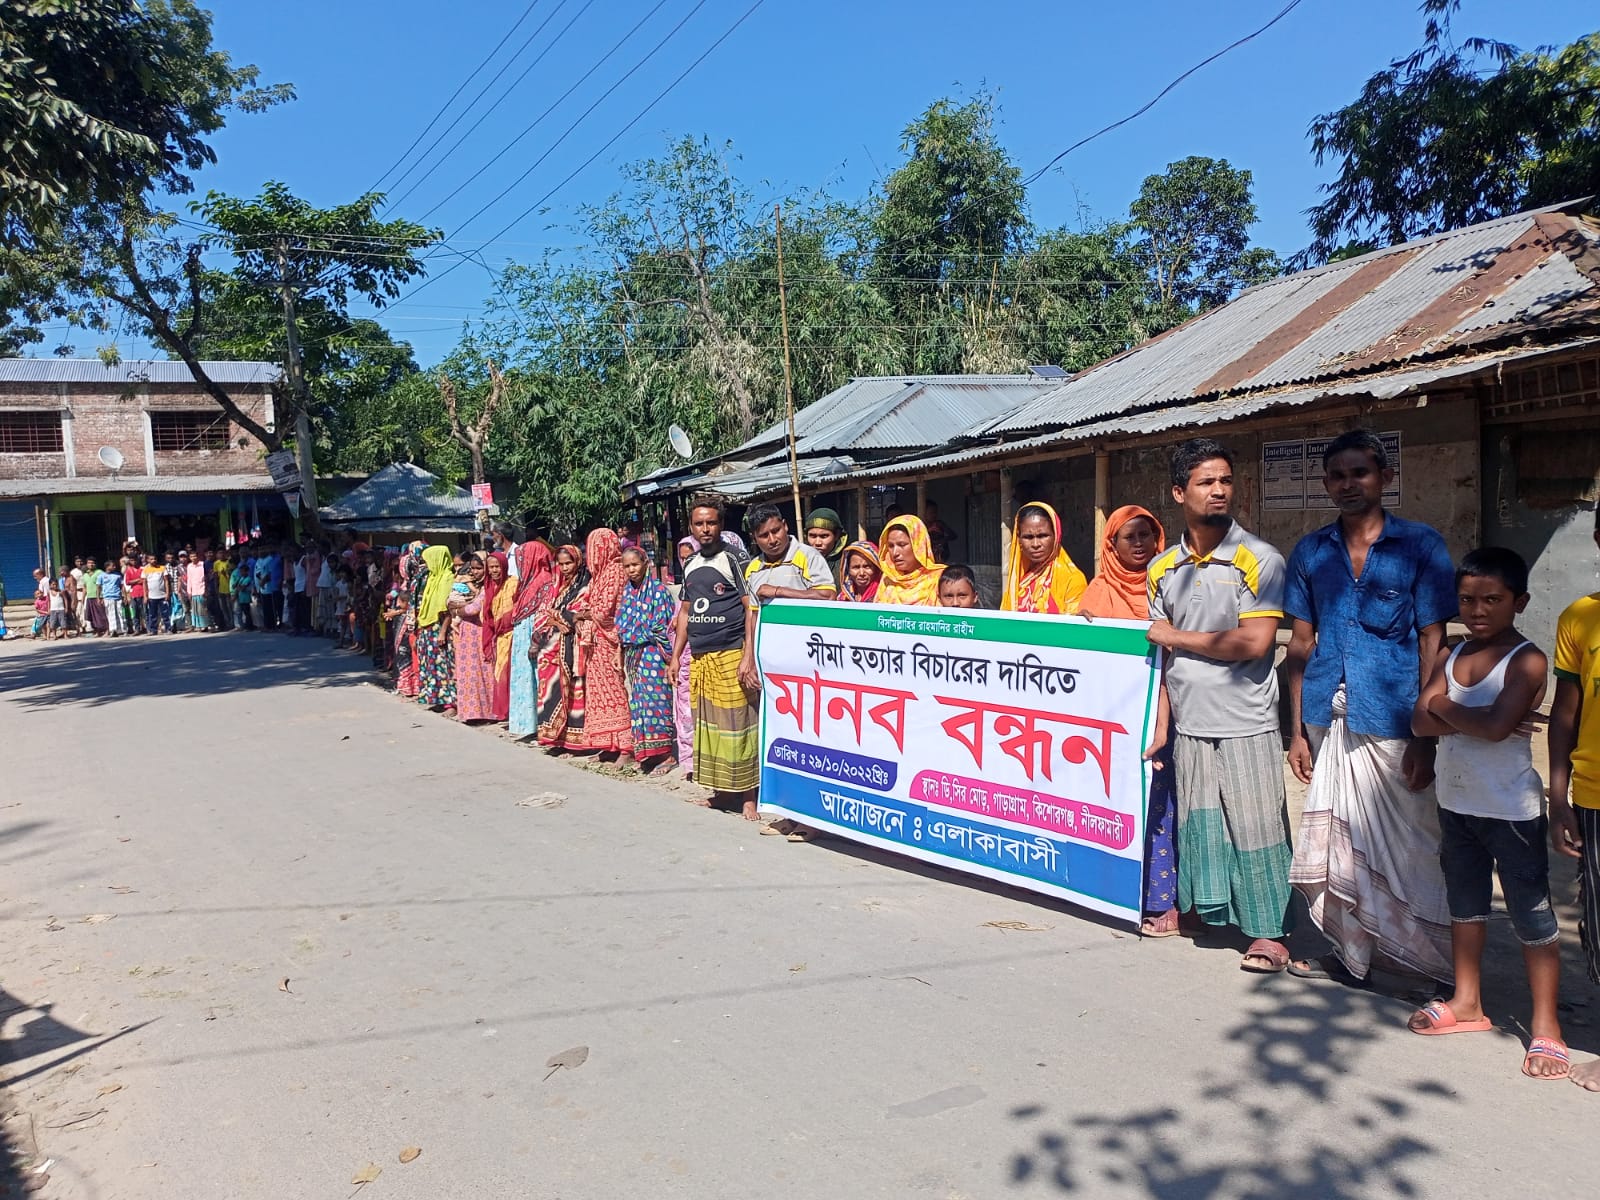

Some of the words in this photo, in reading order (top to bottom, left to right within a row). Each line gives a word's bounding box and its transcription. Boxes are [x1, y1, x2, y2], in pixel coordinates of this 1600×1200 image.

[688, 613, 726, 624] dafone
[806, 632, 845, 669] সীমা
[849, 645, 906, 675] হত্যার
[910, 642, 991, 687] বিচারের
[996, 653, 1080, 694] দাবিতে
[764, 671, 919, 755] মানব
[933, 695, 1129, 799] বন্ধন
[774, 744, 799, 764] তারিখ
[819, 788, 908, 839] আয়োজনে
[928, 821, 1061, 872] এলাকাবাসী
